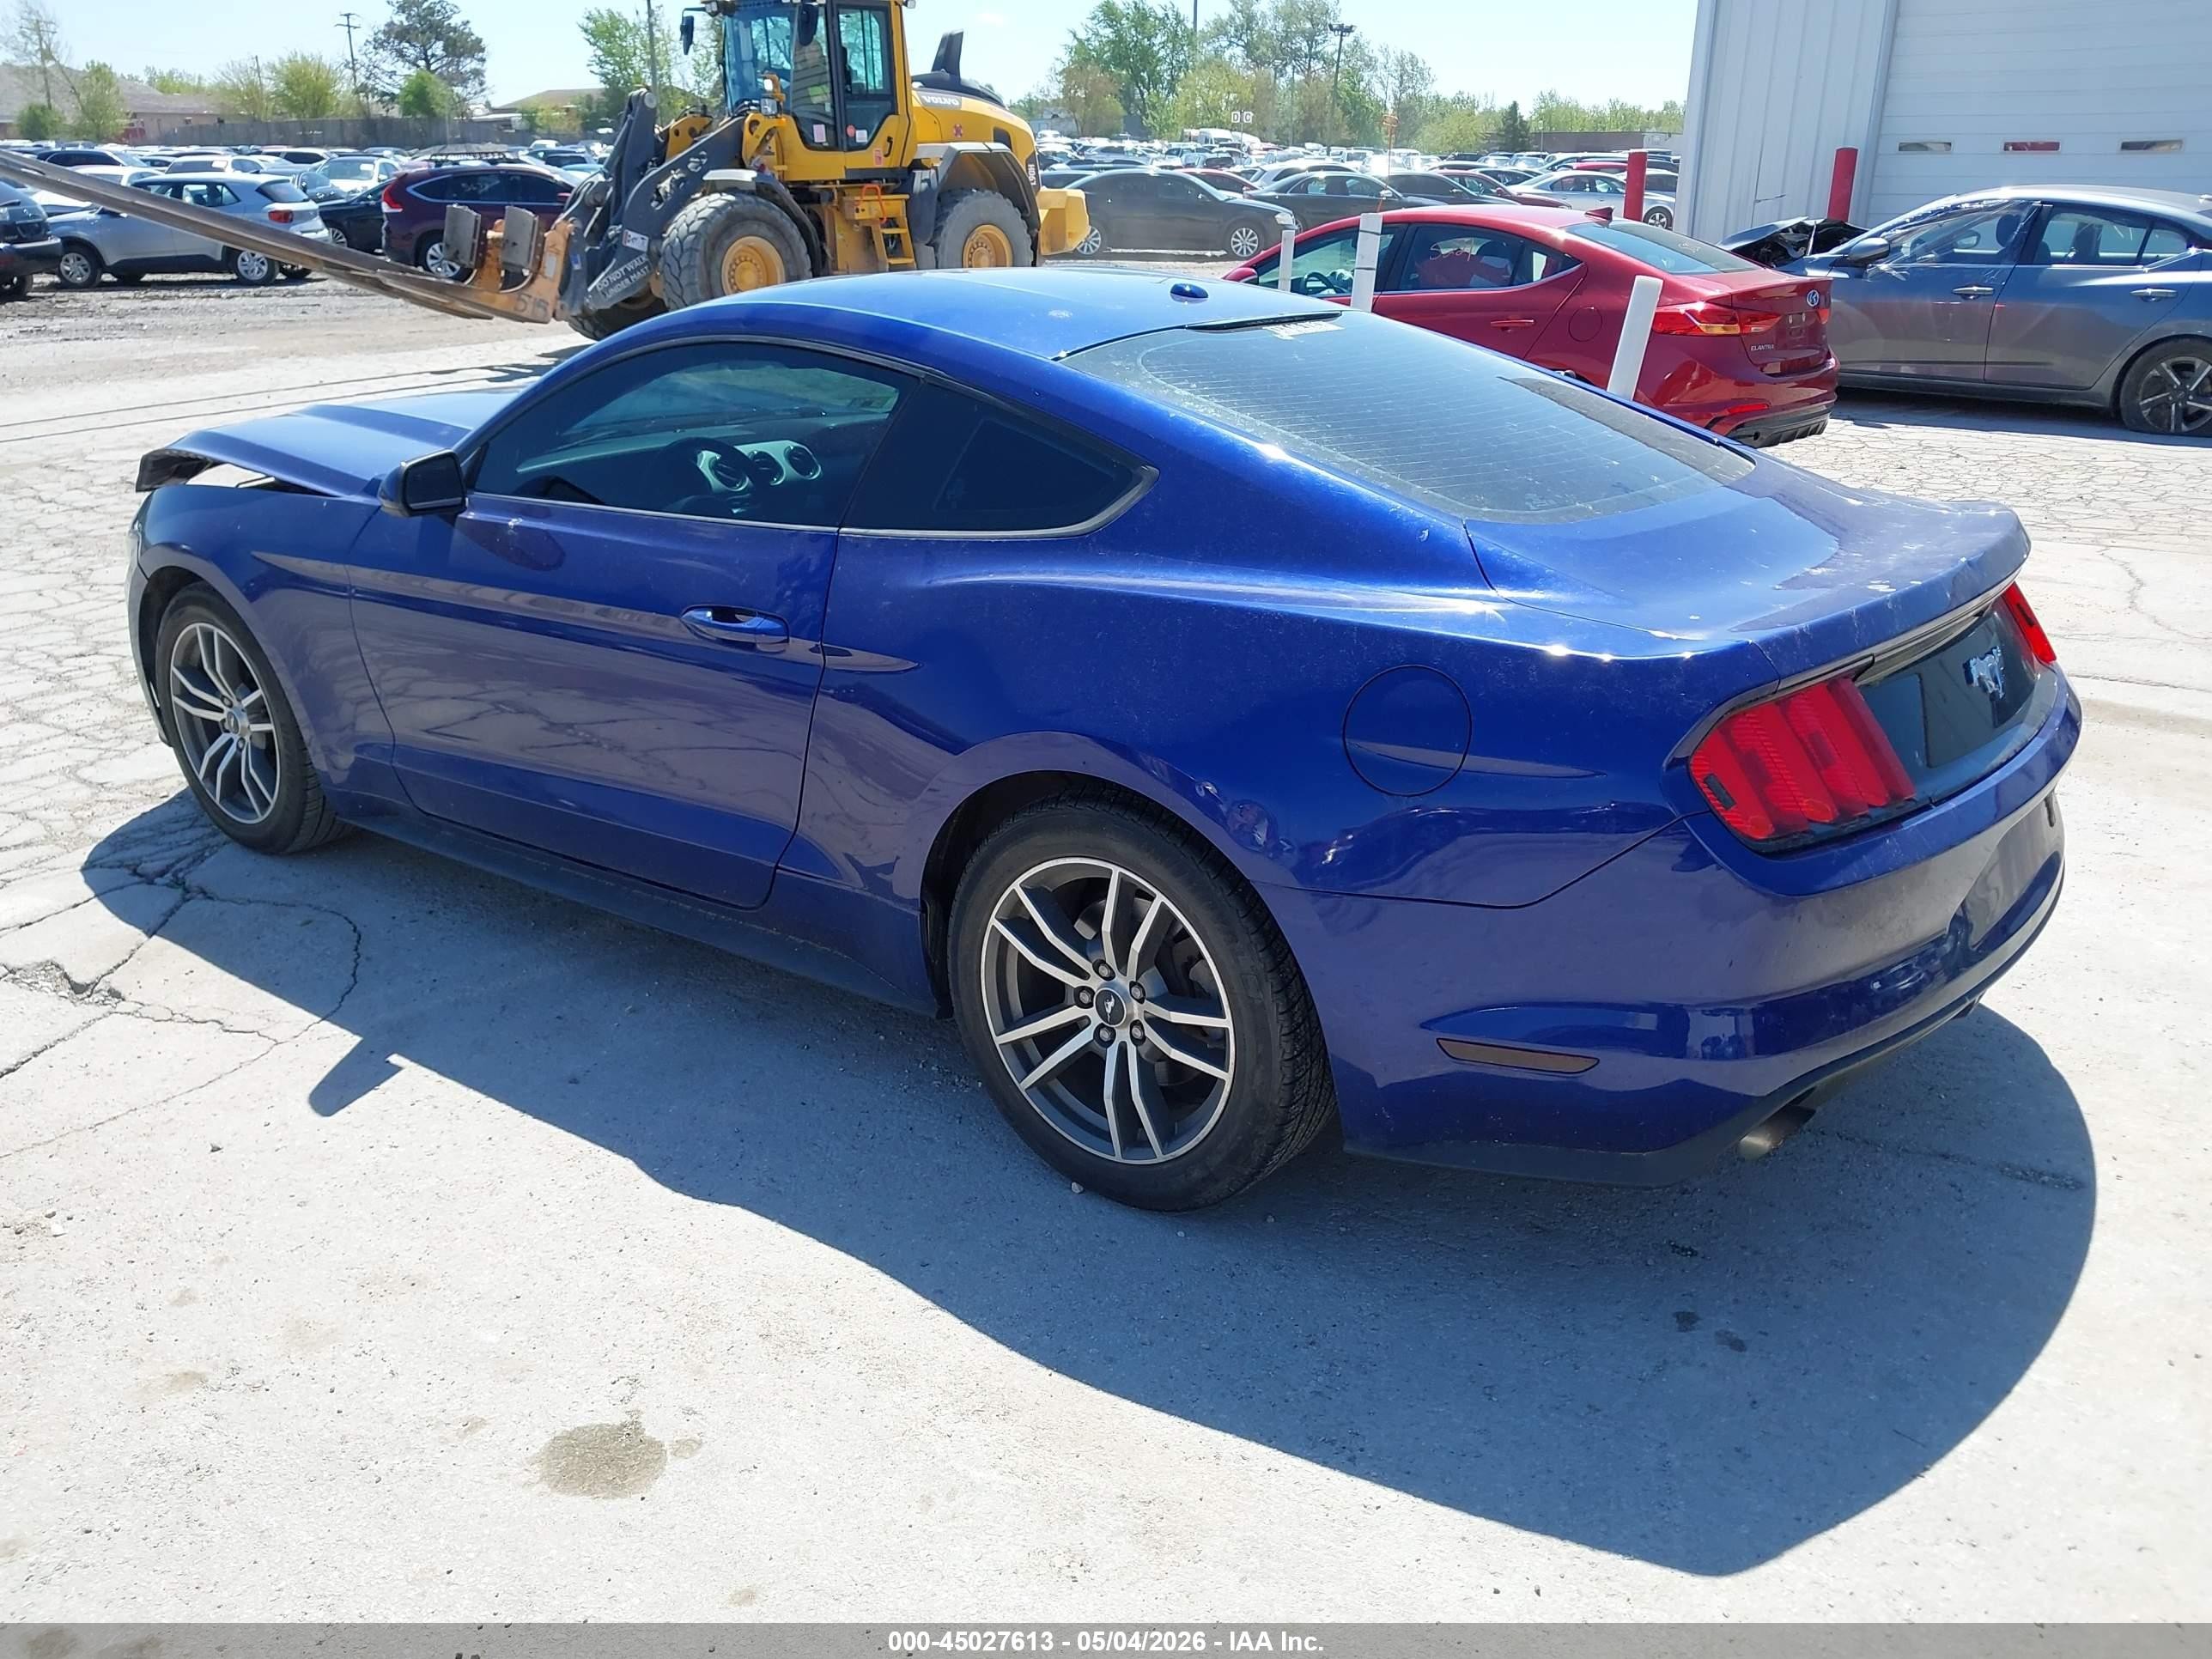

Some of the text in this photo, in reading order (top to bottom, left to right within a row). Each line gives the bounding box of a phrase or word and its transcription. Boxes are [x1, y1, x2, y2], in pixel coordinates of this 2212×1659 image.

[921, 95, 960, 106] VOLVO
[1028, 164, 1037, 185] L90H
[596, 278, 610, 293] DO
[609, 267, 627, 283] NOT
[603, 265, 651, 299] UNDER MAST
